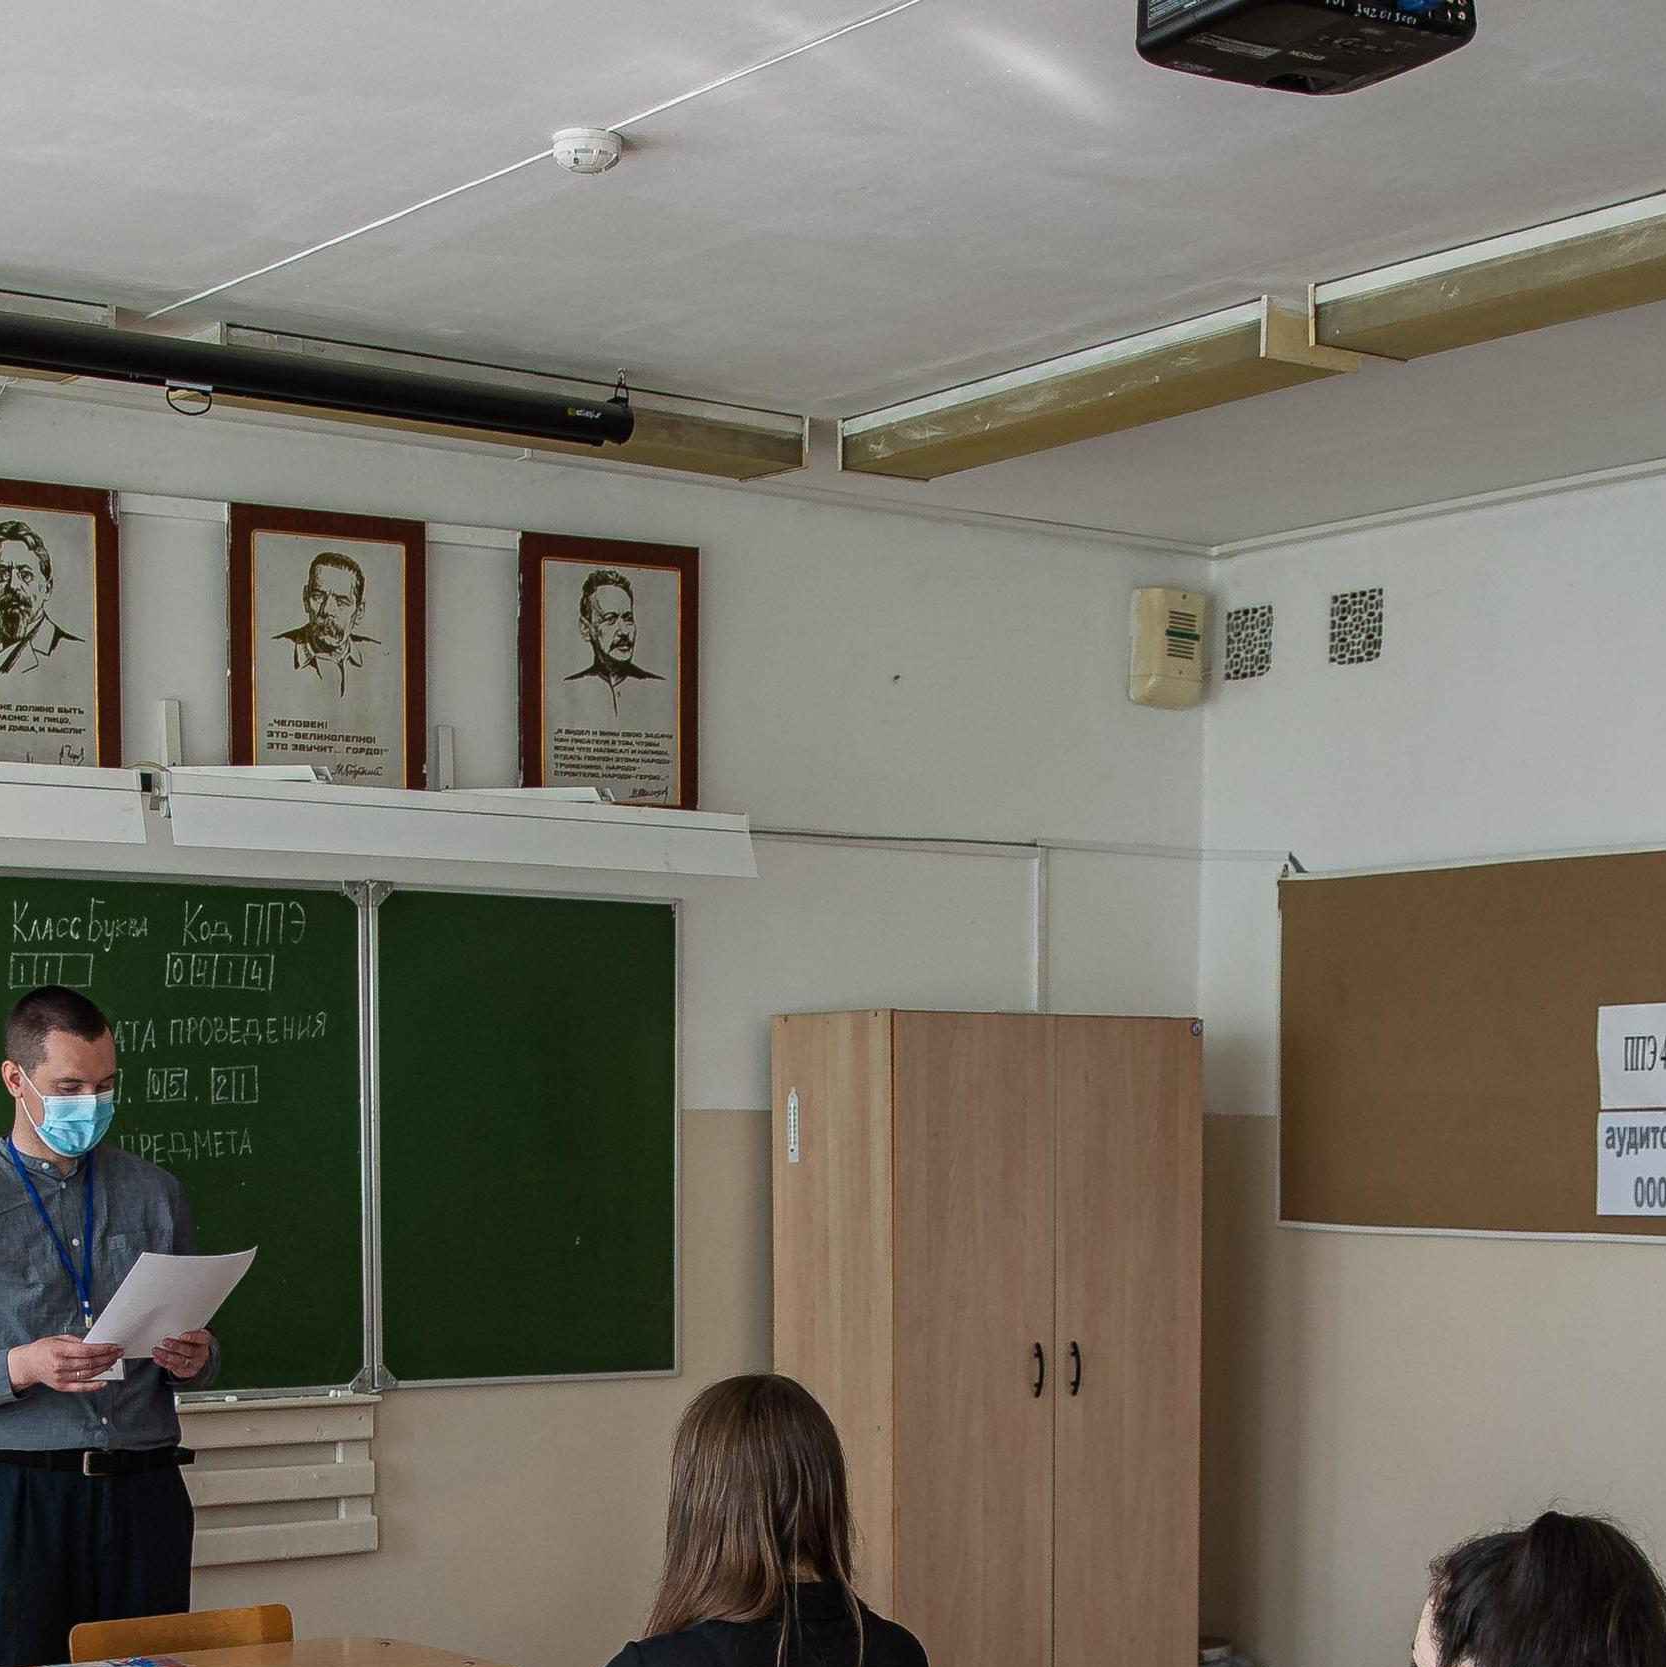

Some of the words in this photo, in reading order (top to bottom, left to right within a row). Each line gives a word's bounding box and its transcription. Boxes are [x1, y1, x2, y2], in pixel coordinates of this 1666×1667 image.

[15, 704, 54, 714] ДОЛЖНО
[57, 706, 85, 715] БЫТЬ
[266, 742, 288, 751] ЭТО
[243, 901, 308, 945] ППЭ
[169, 1011, 328, 1047] ПРОВЕДЕНИЯ
[1623, 1035, 1658, 1071] ППЭ
